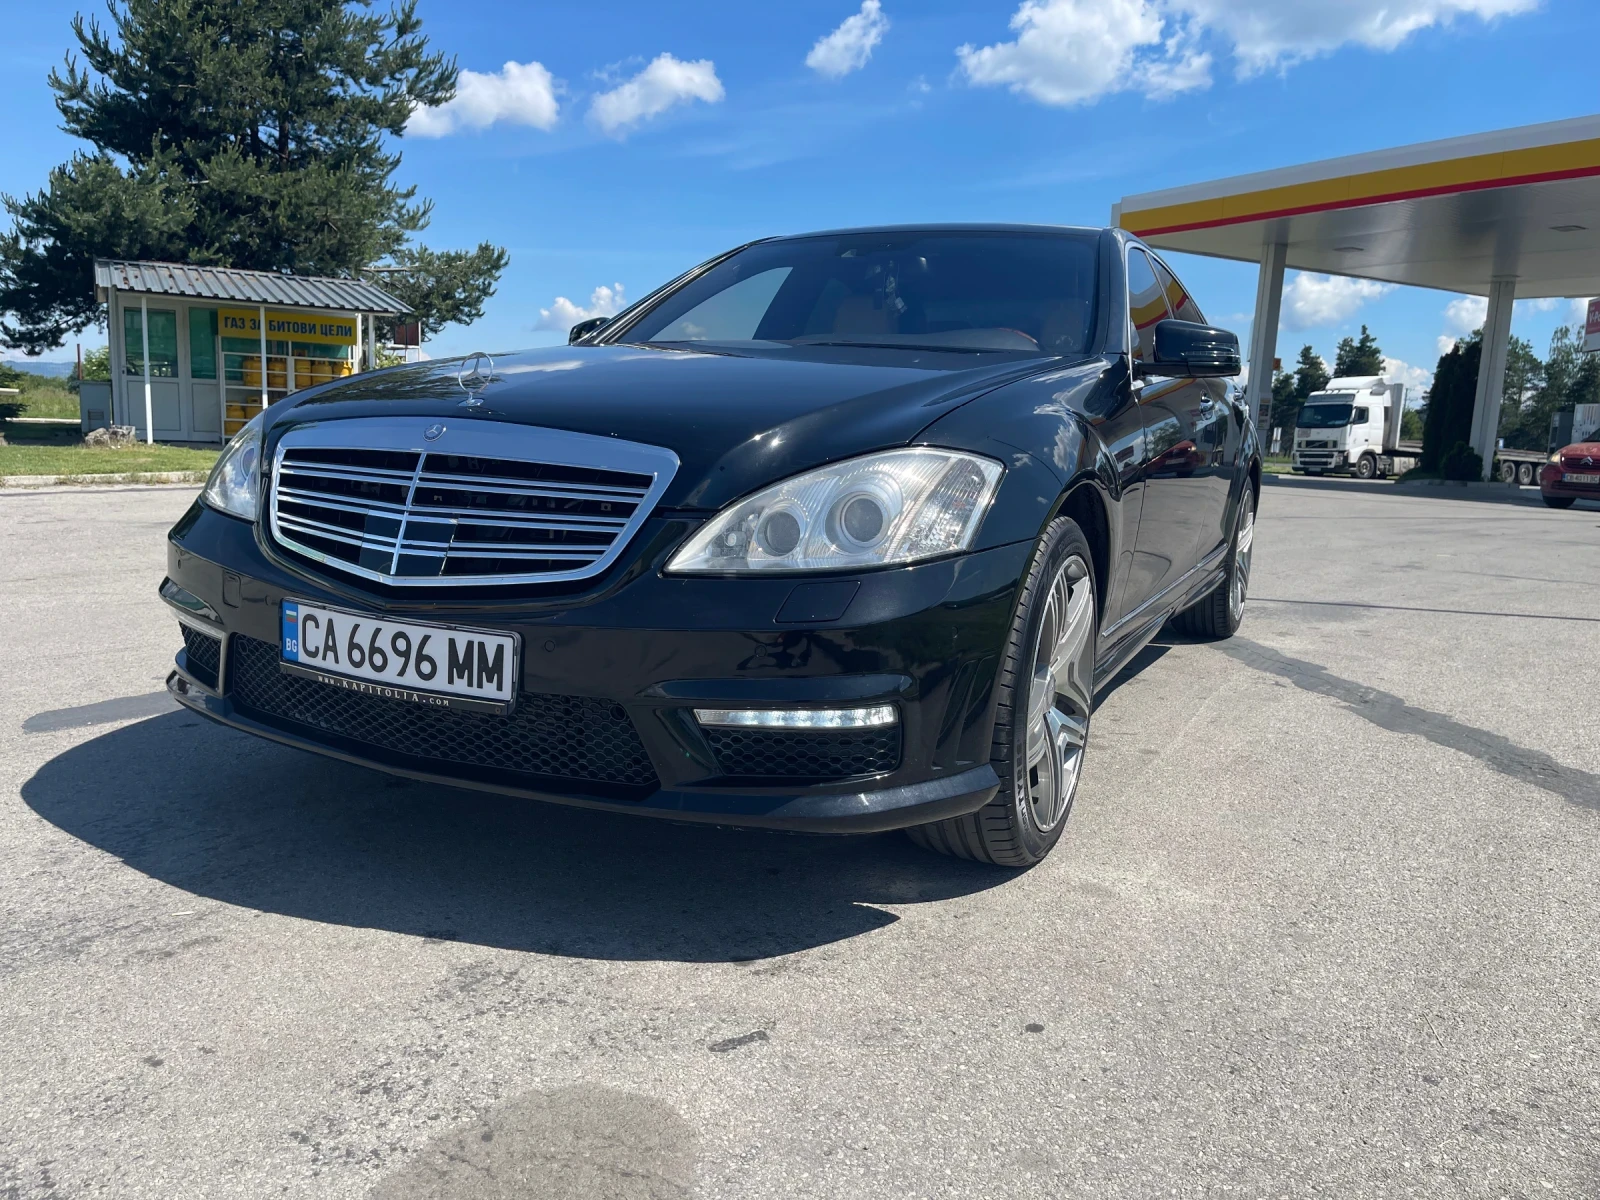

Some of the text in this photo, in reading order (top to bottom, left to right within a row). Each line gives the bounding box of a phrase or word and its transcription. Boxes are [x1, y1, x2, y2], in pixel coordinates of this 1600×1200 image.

[224, 316, 246, 329] ГАЗ
[268, 319, 317, 335] БИТОВИ
[320, 323, 353, 338] ЦЕЛИ
[286, 638, 298, 652] BG
[302, 613, 505, 692] CA 6696 MM
